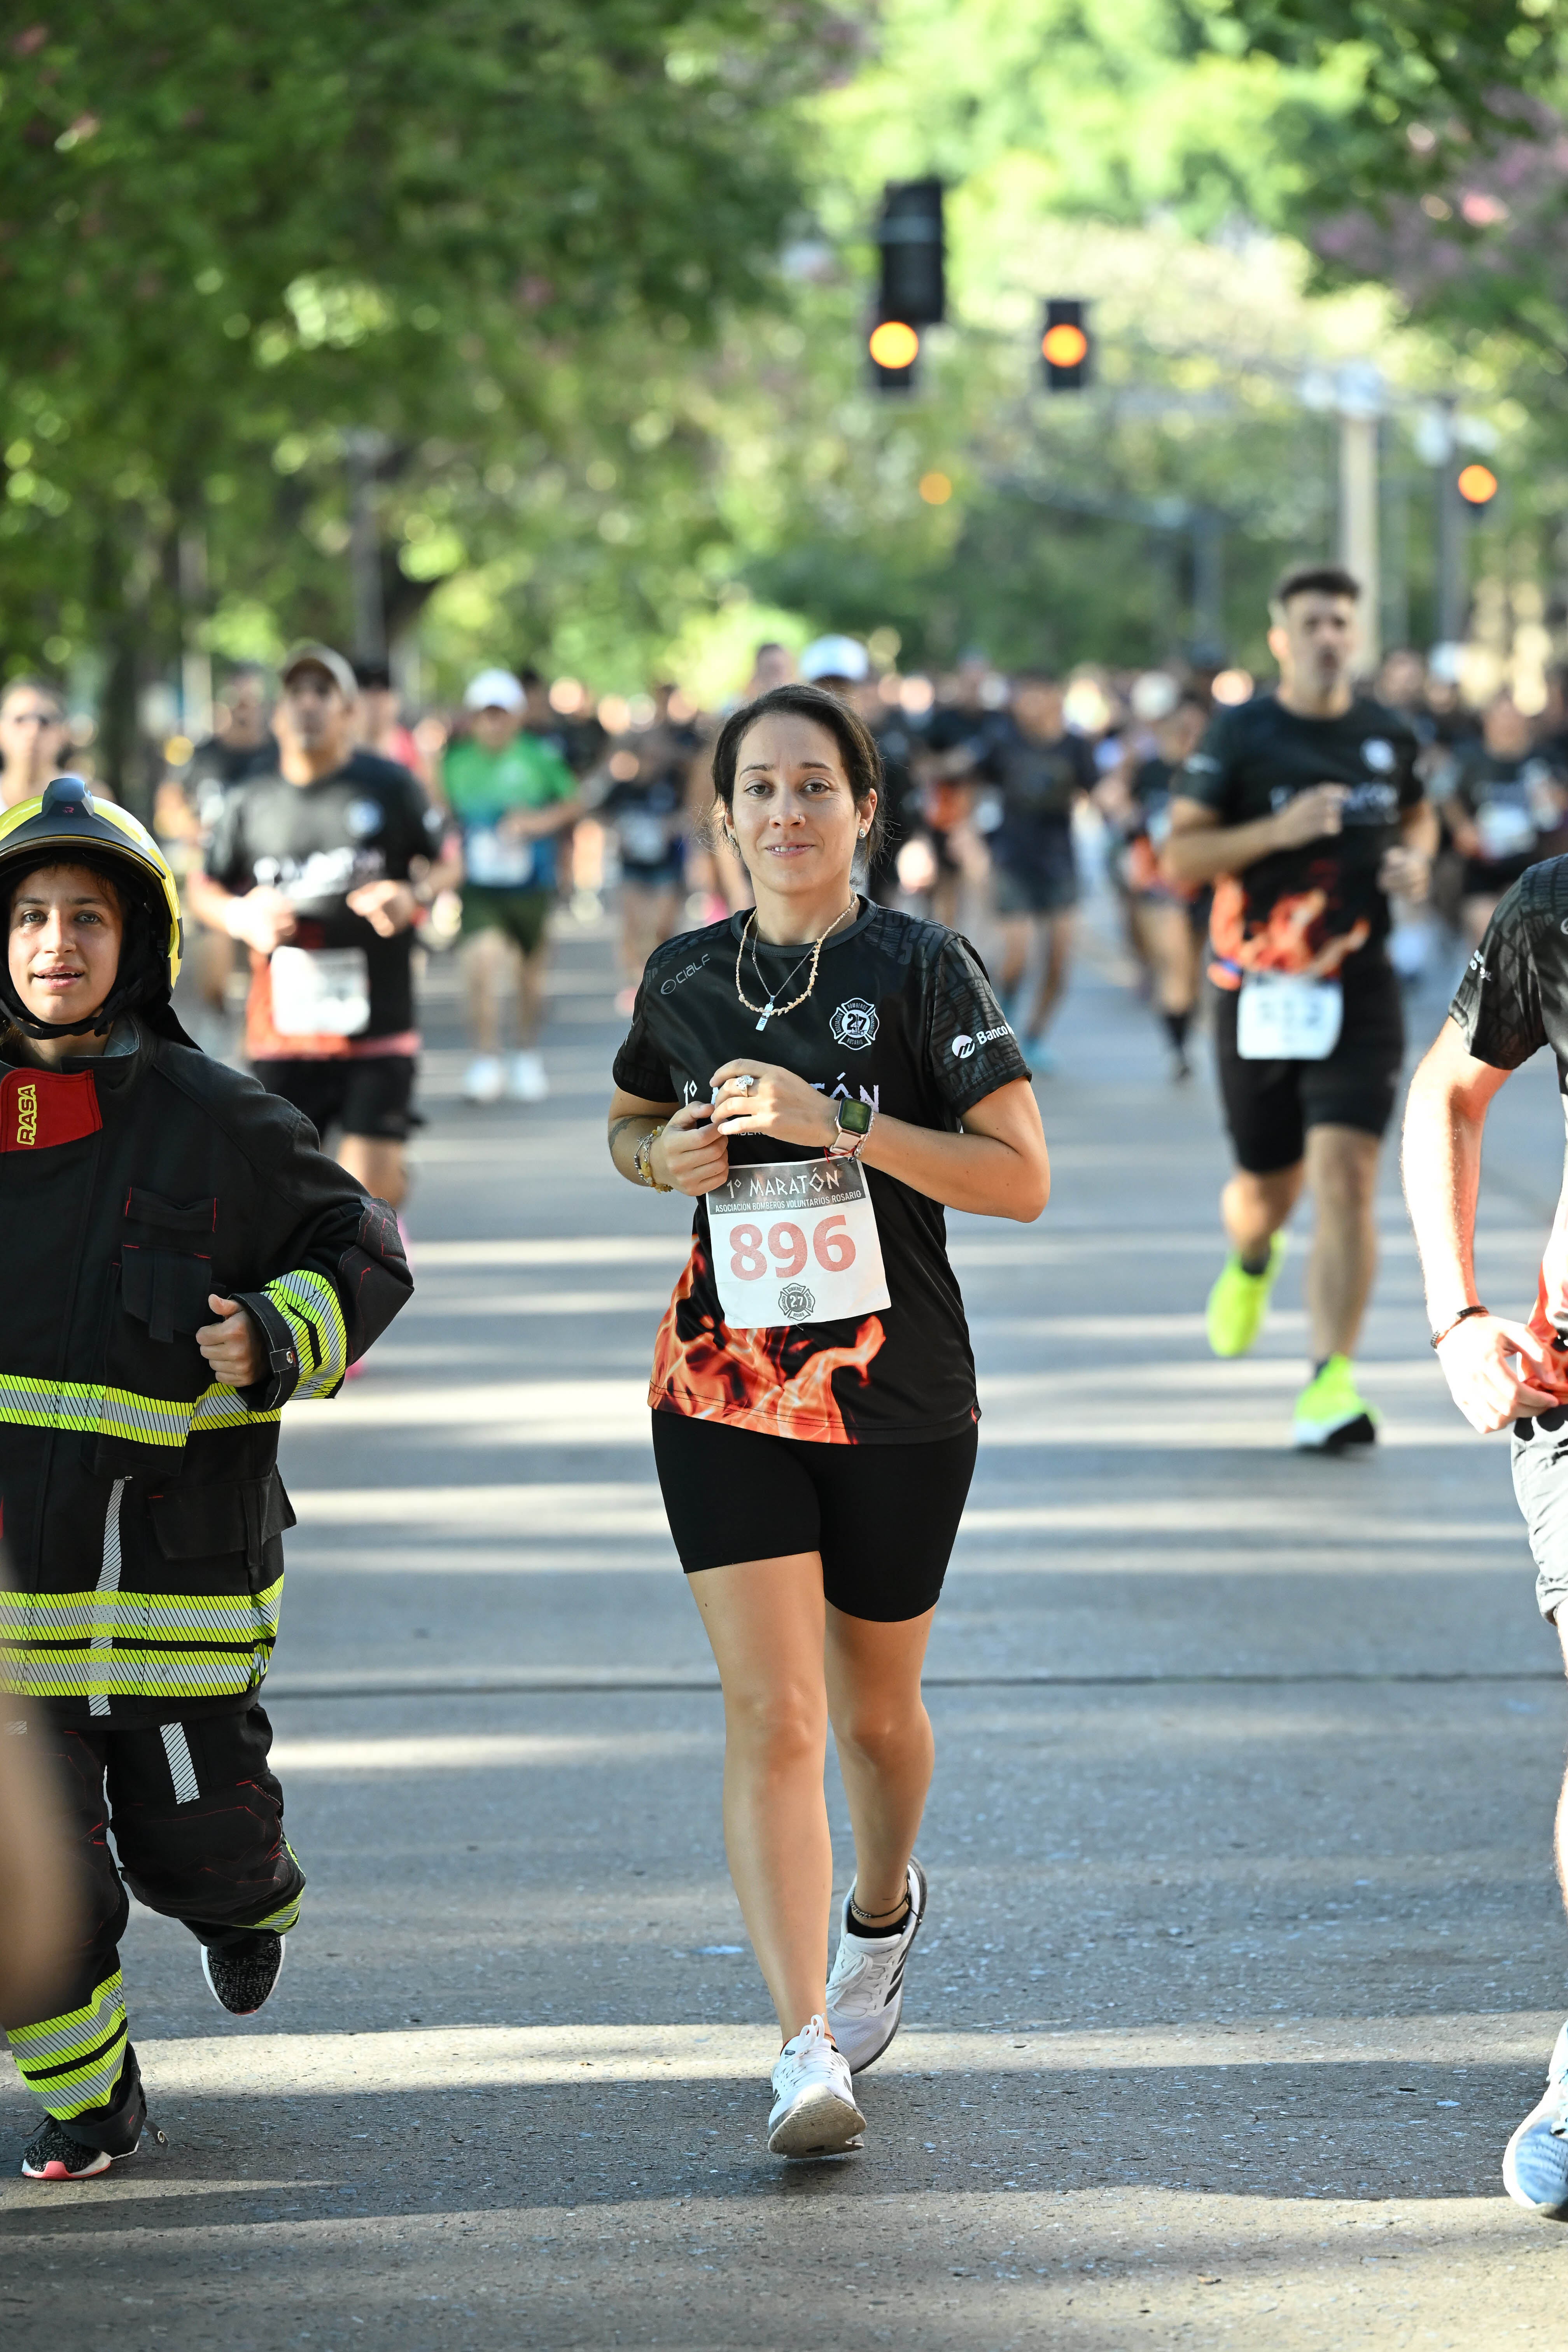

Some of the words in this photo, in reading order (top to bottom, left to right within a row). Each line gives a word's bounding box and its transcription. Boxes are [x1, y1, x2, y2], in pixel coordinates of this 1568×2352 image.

[847, 1013, 867, 1030] 27
[976, 1026, 1008, 1045] Banco
[17, 1084, 37, 1145] RASA
[750, 1167, 840, 1197] MARATÓN
[715, 1201, 751, 1213] ASOCIACIÓN
[752, 1200, 785, 1211] BOMBEROS
[786, 1196, 830, 1208] VOLUNTARIOS
[831, 1190, 862, 1203] ROSARIO
[730, 1214, 856, 1281] 896
[790, 1295, 803, 1307] 27
